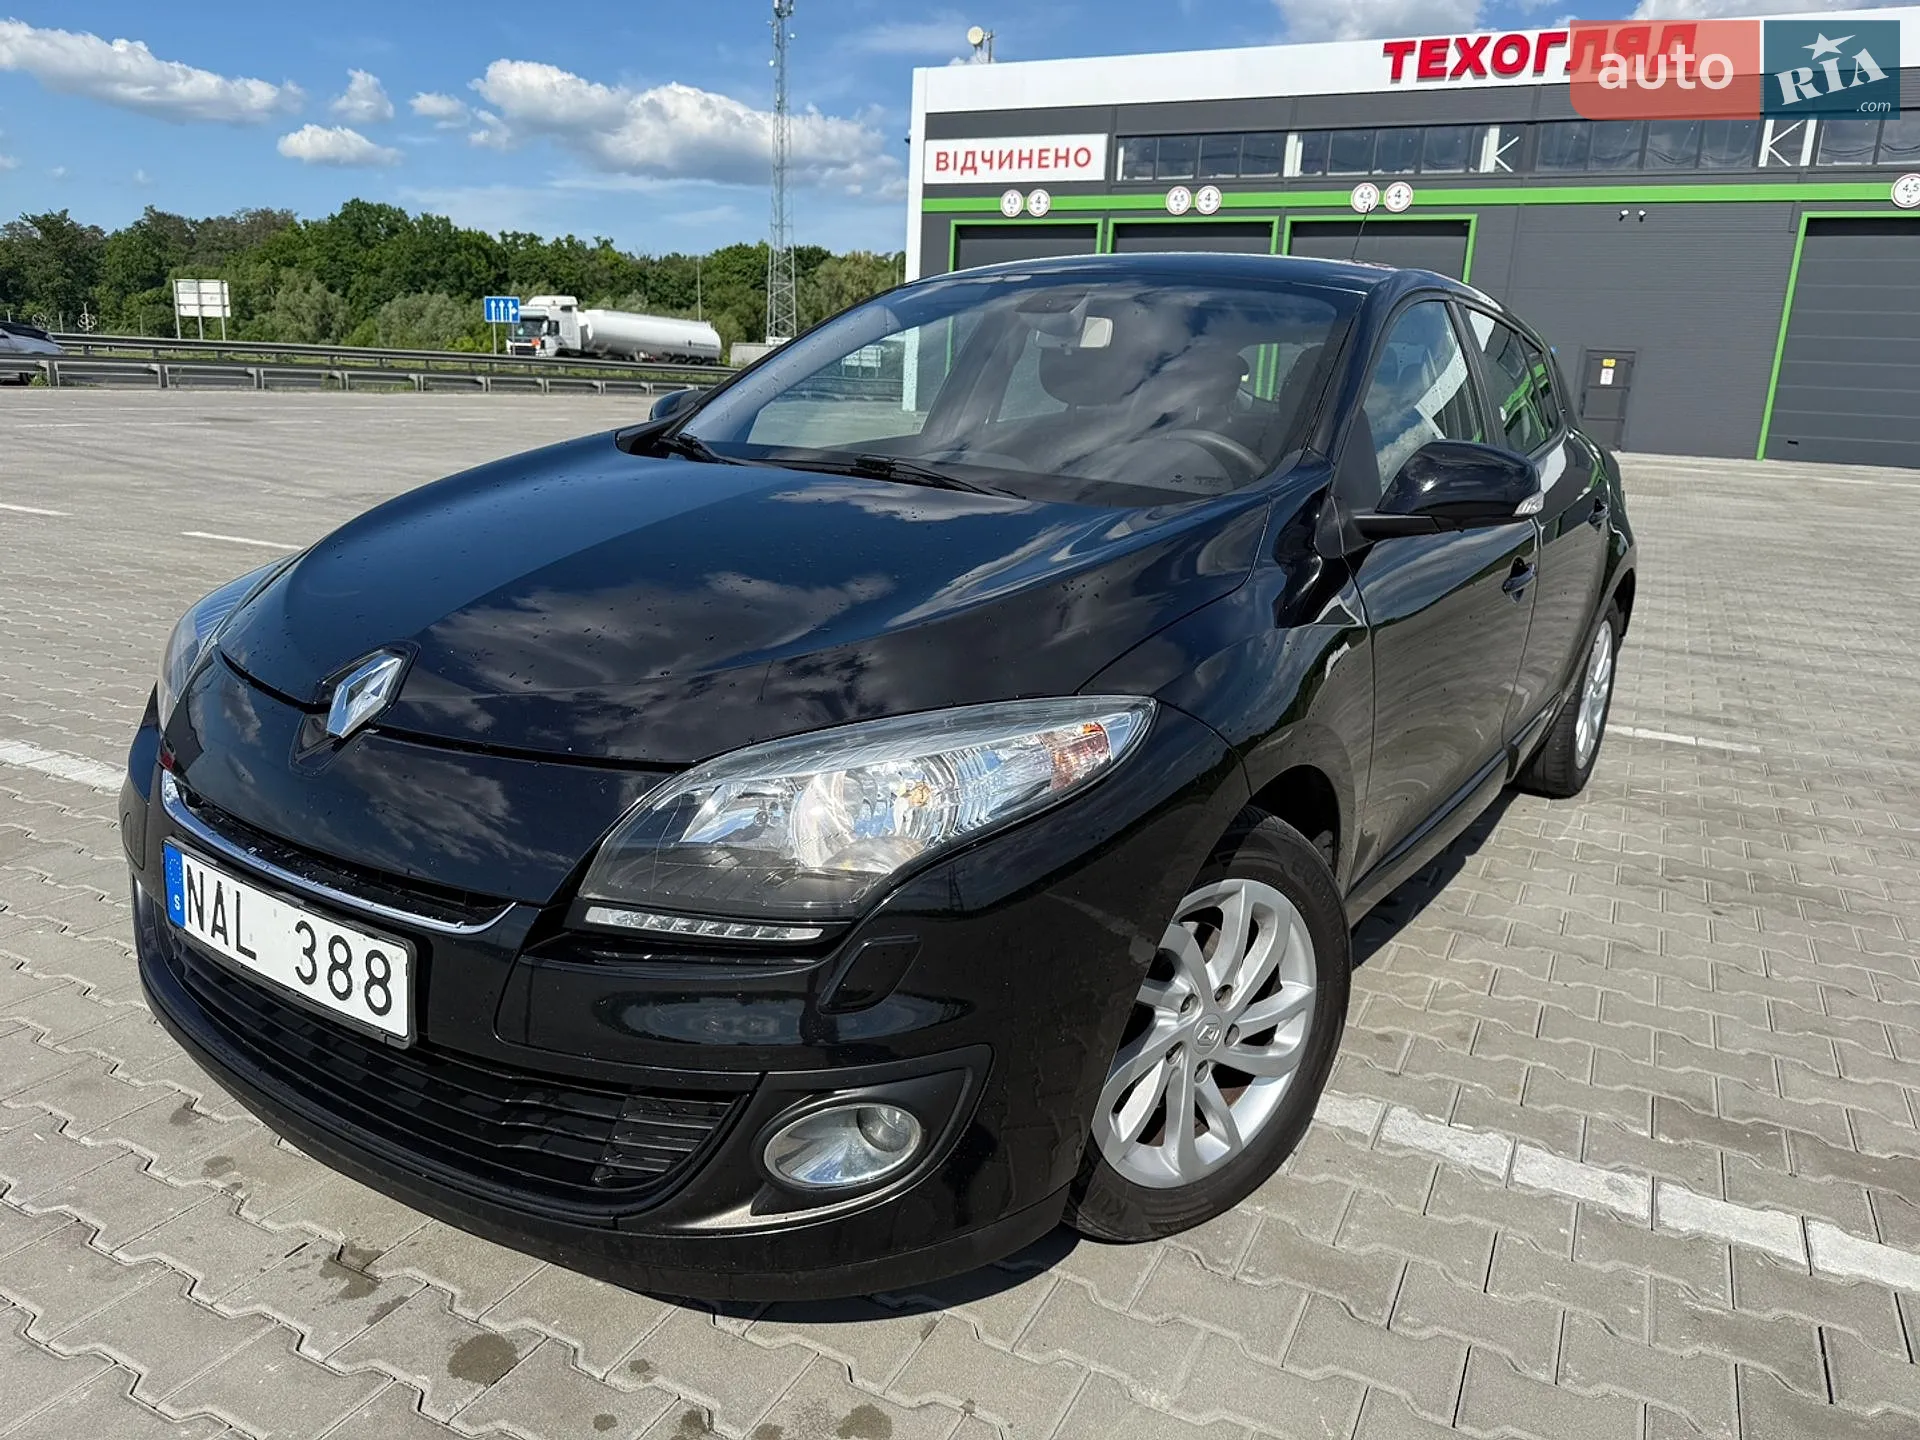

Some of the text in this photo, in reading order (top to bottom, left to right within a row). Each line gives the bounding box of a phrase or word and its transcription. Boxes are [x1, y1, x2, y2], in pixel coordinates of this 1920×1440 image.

[1383, 24, 1698, 83] ТЕХОГЛЯД
[935, 147, 1092, 176] ВІДЧИНЕНО
[174, 894, 181, 911] S
[186, 864, 392, 1016] NAL 388
